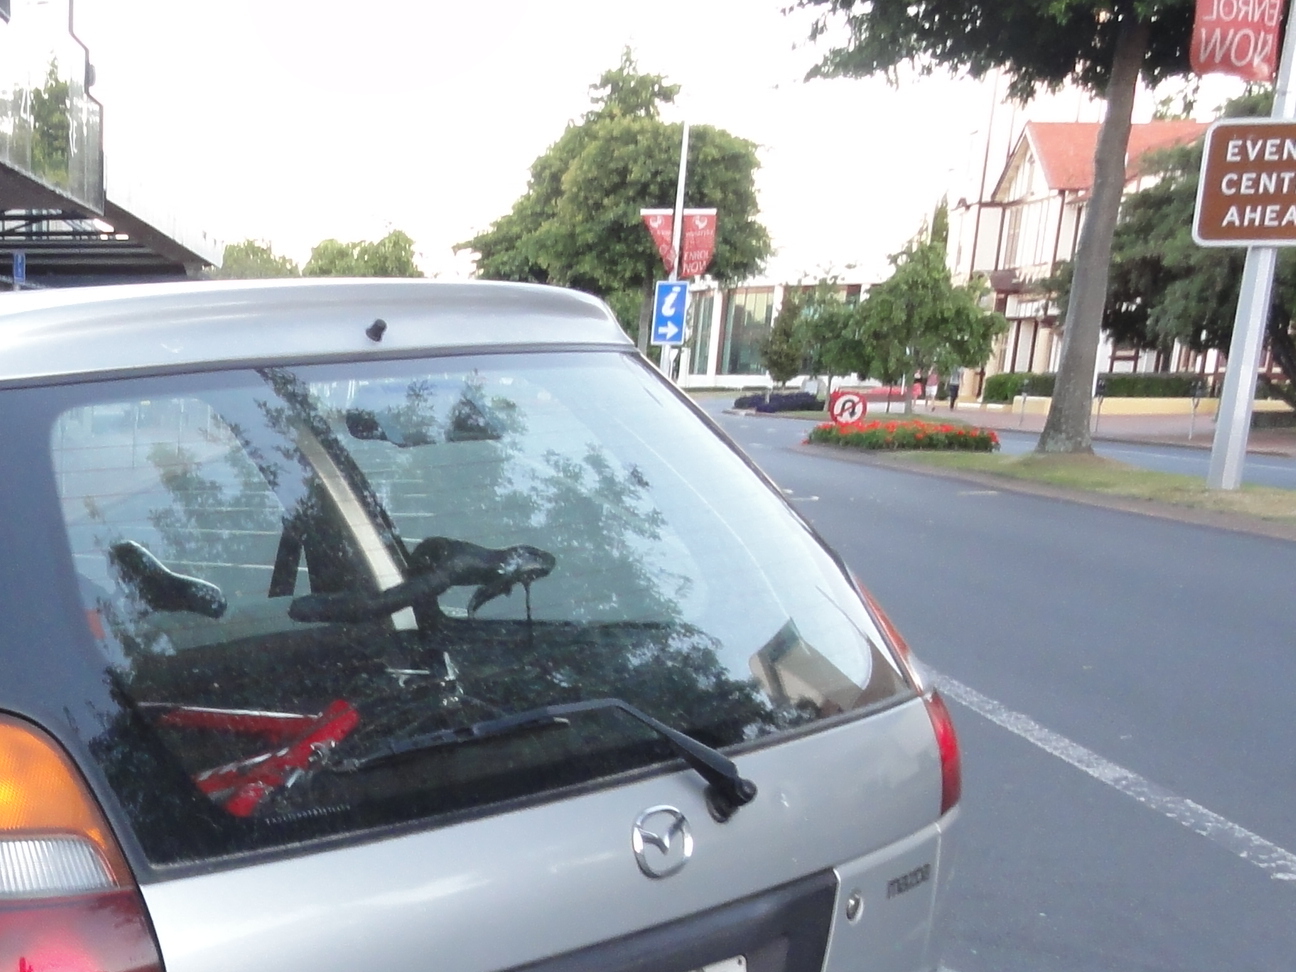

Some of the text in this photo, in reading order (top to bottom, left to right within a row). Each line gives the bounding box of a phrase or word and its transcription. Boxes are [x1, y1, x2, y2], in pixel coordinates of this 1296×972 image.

[1226, 138, 1296, 162] EVEN
[1221, 172, 1296, 196] CENT
[1221, 205, 1296, 228] AHEA
